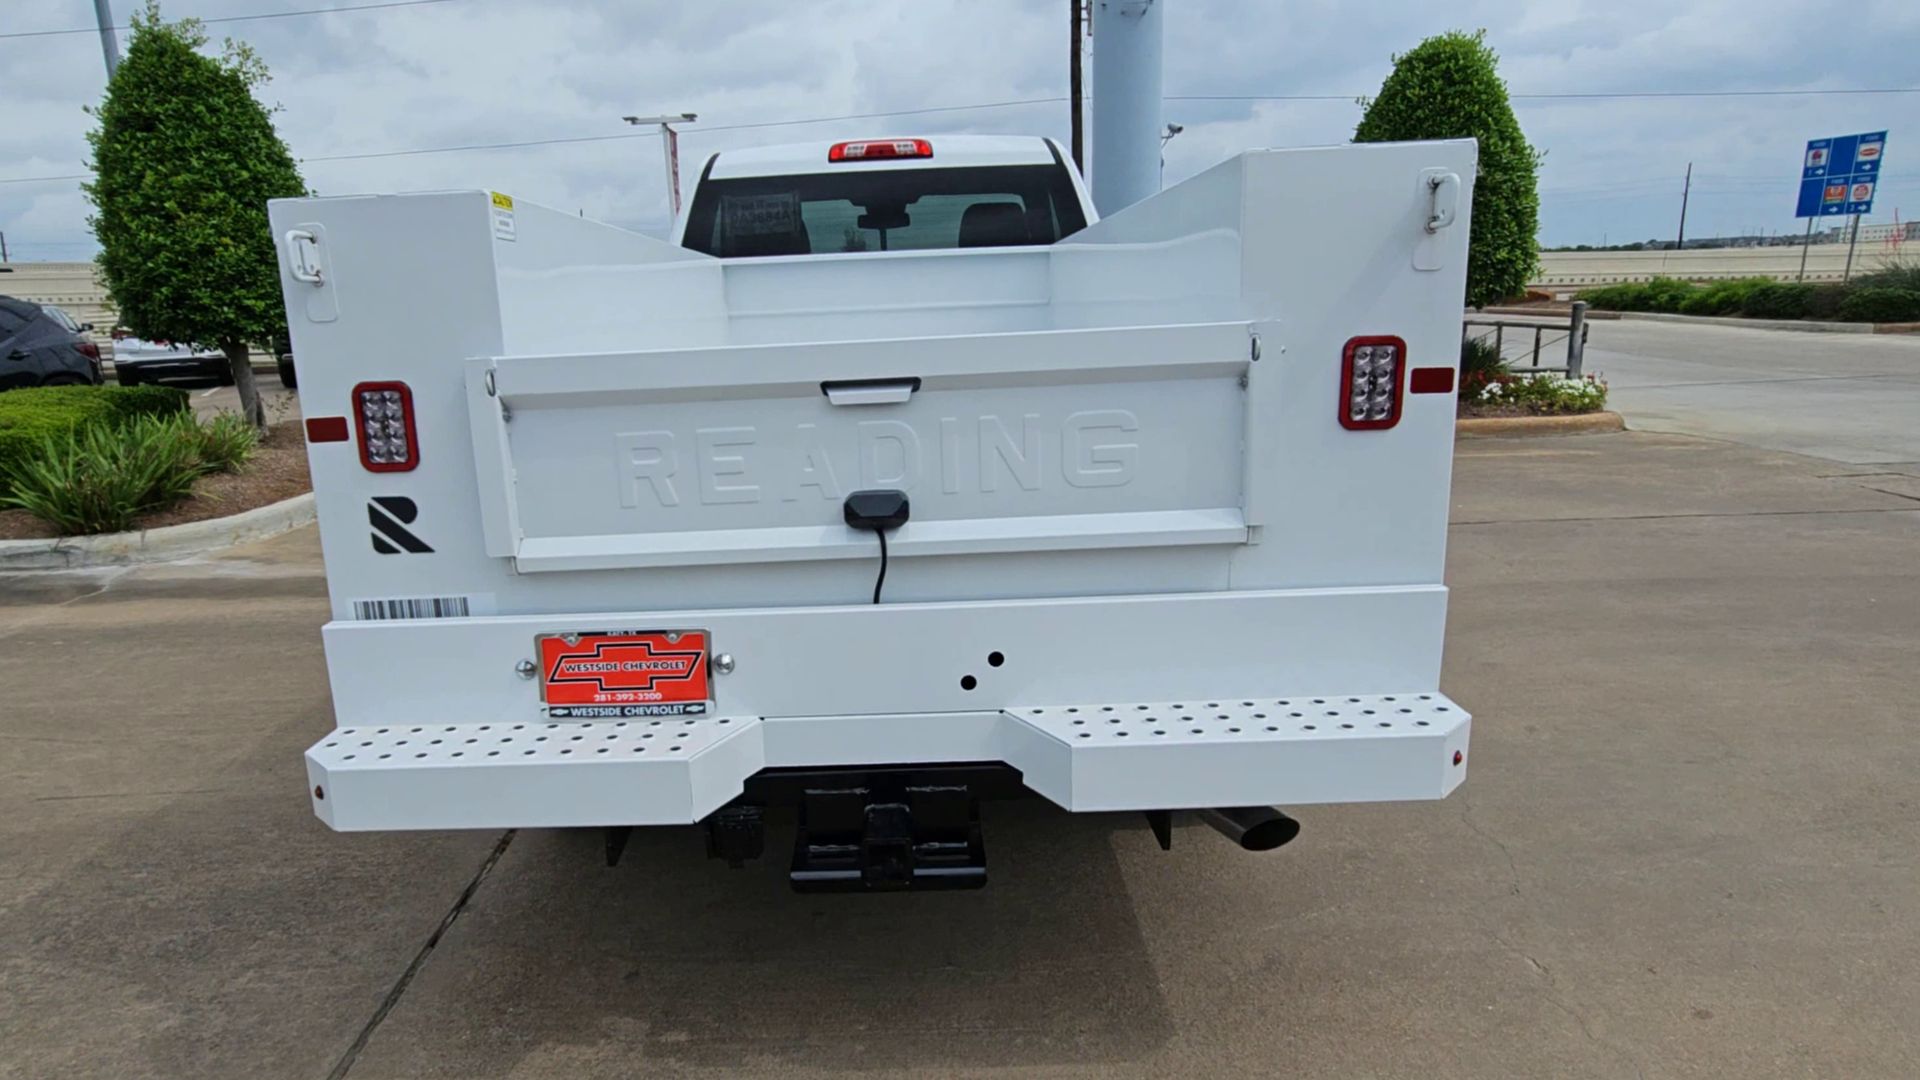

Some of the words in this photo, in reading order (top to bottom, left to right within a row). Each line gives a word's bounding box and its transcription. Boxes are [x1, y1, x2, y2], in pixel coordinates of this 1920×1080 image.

[614, 409, 1140, 509] READING
[564, 662, 620, 672] WESTSIDE
[623, 660, 687, 671] CHEVROLET
[593, 692, 663, 702] 281-392-3200
[570, 705, 622, 717] WESTSIDE
[624, 704, 685, 716] CHEVROLET
